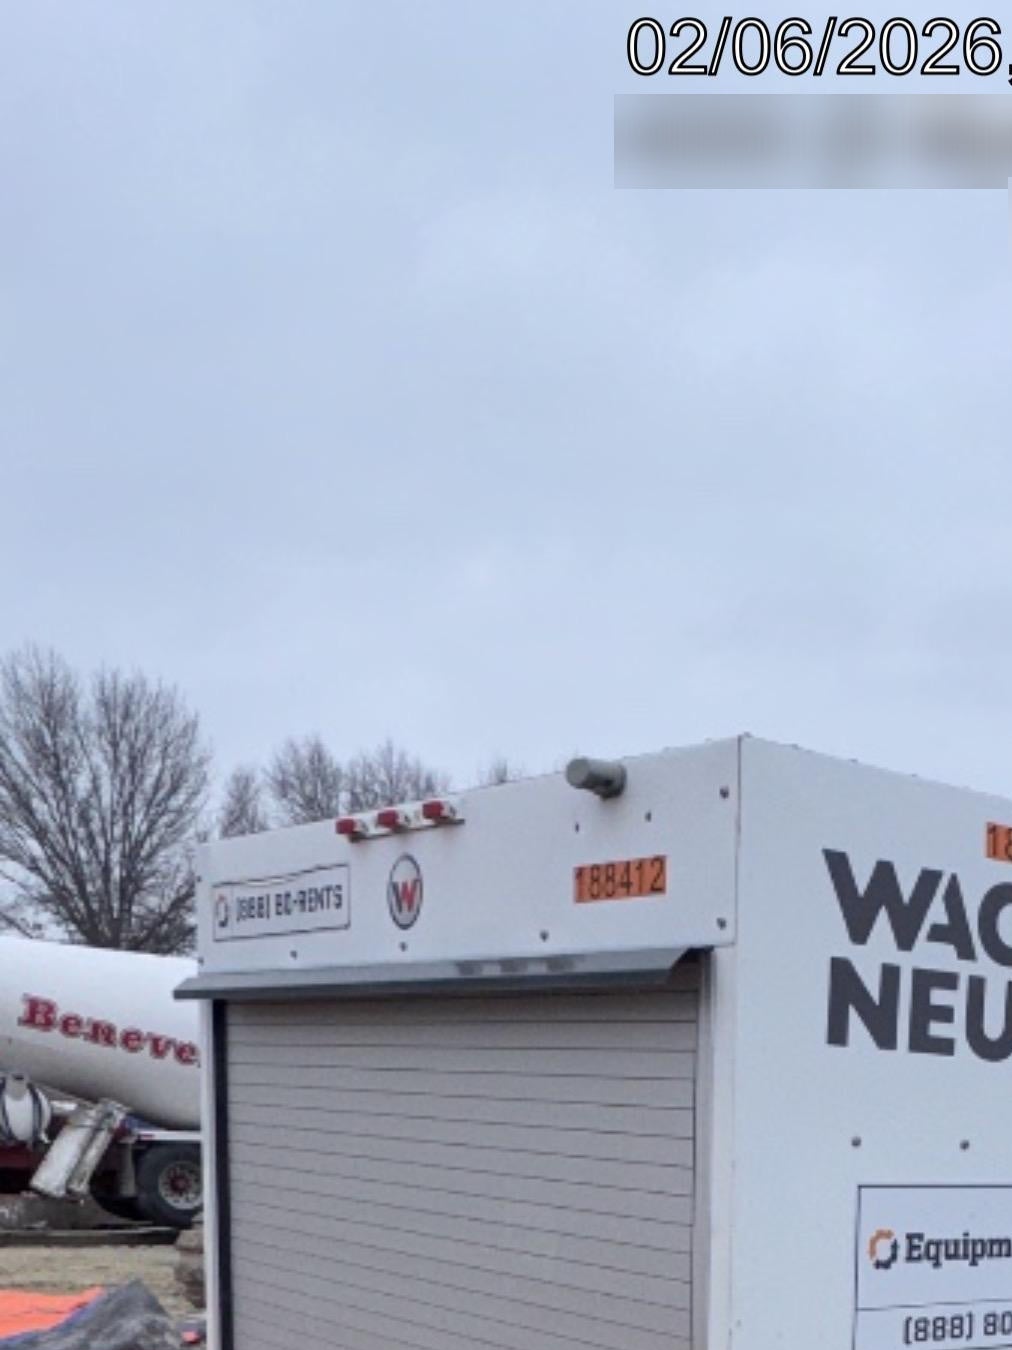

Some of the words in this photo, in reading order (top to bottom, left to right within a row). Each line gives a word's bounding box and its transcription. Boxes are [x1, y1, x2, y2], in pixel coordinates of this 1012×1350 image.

[575, 855, 666, 902] 188412
[18, 993, 201, 1068] Beneve
[904, 1312, 973, 1345] (888)
